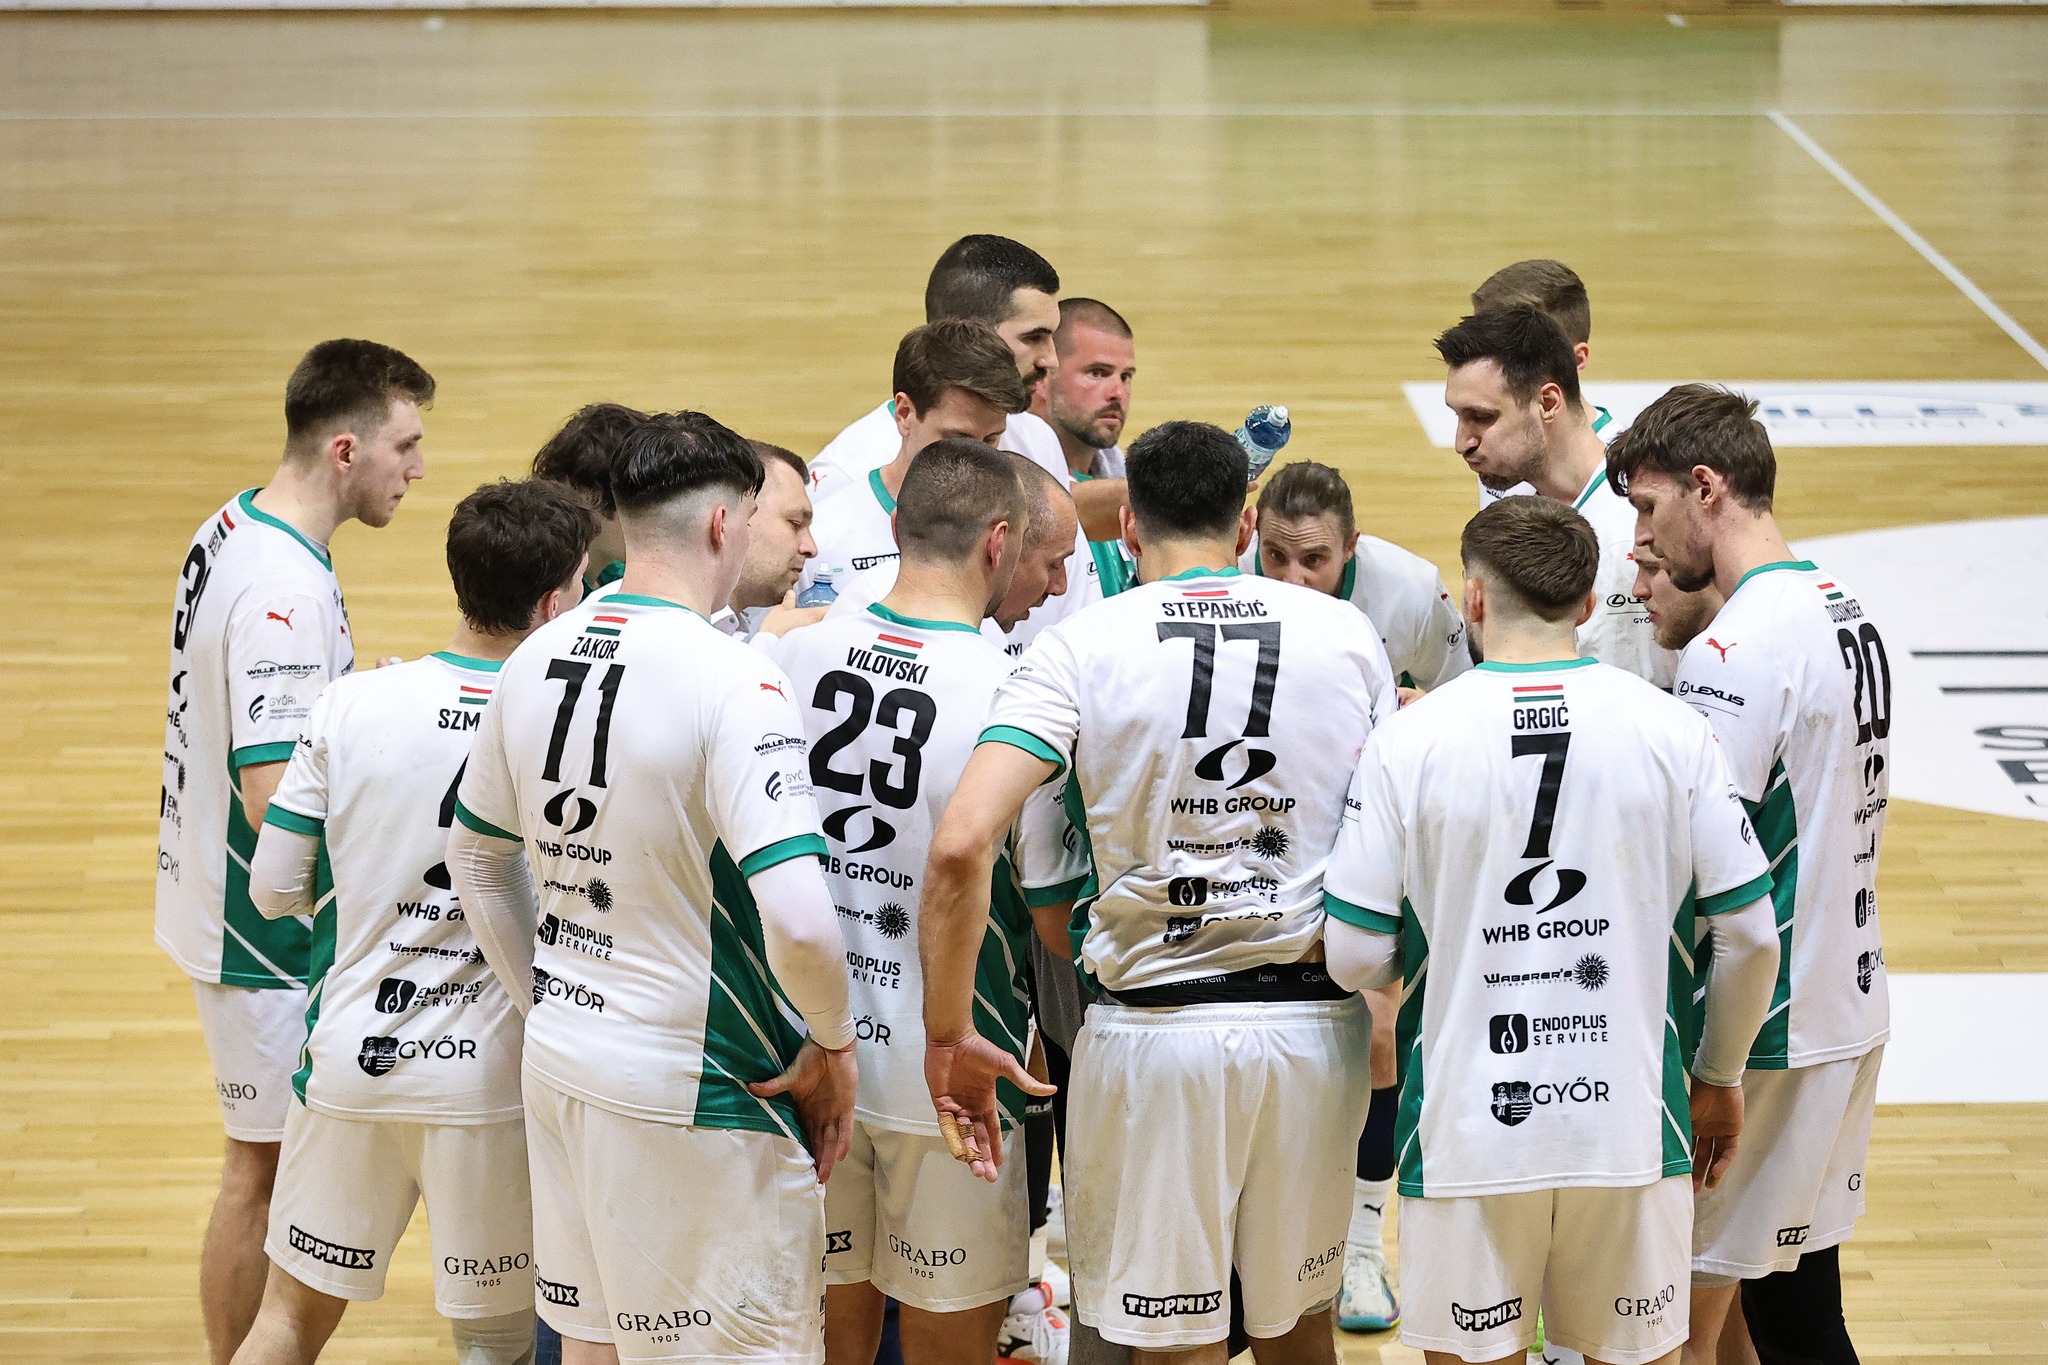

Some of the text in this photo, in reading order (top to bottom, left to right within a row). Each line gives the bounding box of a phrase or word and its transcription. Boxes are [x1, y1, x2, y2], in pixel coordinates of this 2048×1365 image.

[1161, 599, 1268, 619] STEPANČIĆ
[570, 636, 620, 660] ZAKOR
[246, 666, 276, 676] WILLE
[846, 646, 929, 685] VILOVSKI
[1155, 621, 1281, 739] 77
[1837, 622, 1891, 747] 20
[1690, 684, 1745, 707] LEXUS
[437, 708, 481, 732] SZM
[541, 658, 626, 789] 71
[1513, 702, 1569, 730] GRGIĆ
[754, 739, 784, 752] WILLE
[809, 669, 937, 810] 23
[1171, 796, 1296, 815] WHB GROUP
[1511, 732, 1572, 859] 7
[845, 862, 914, 891] GROUP
[396, 902, 441, 921] WHB
[1482, 918, 1610, 945] WHB GROUP
[559, 934, 612, 961] SERVICE
[547, 977, 605, 1013] GYŐR
[398, 1036, 477, 1060] GYŐR
[1533, 1031, 1608, 1046] SERVICE
[1532, 1077, 1610, 1105] GYŐR
[889, 1233, 967, 1267] GRABO
[444, 1252, 530, 1276] GRABO
[909, 1266, 934, 1279] 1905
[476, 1278, 501, 1288] 1905
[1614, 1284, 1675, 1317] GRABO
[616, 1309, 712, 1332] GRABO
[650, 1333, 681, 1344] 1905
